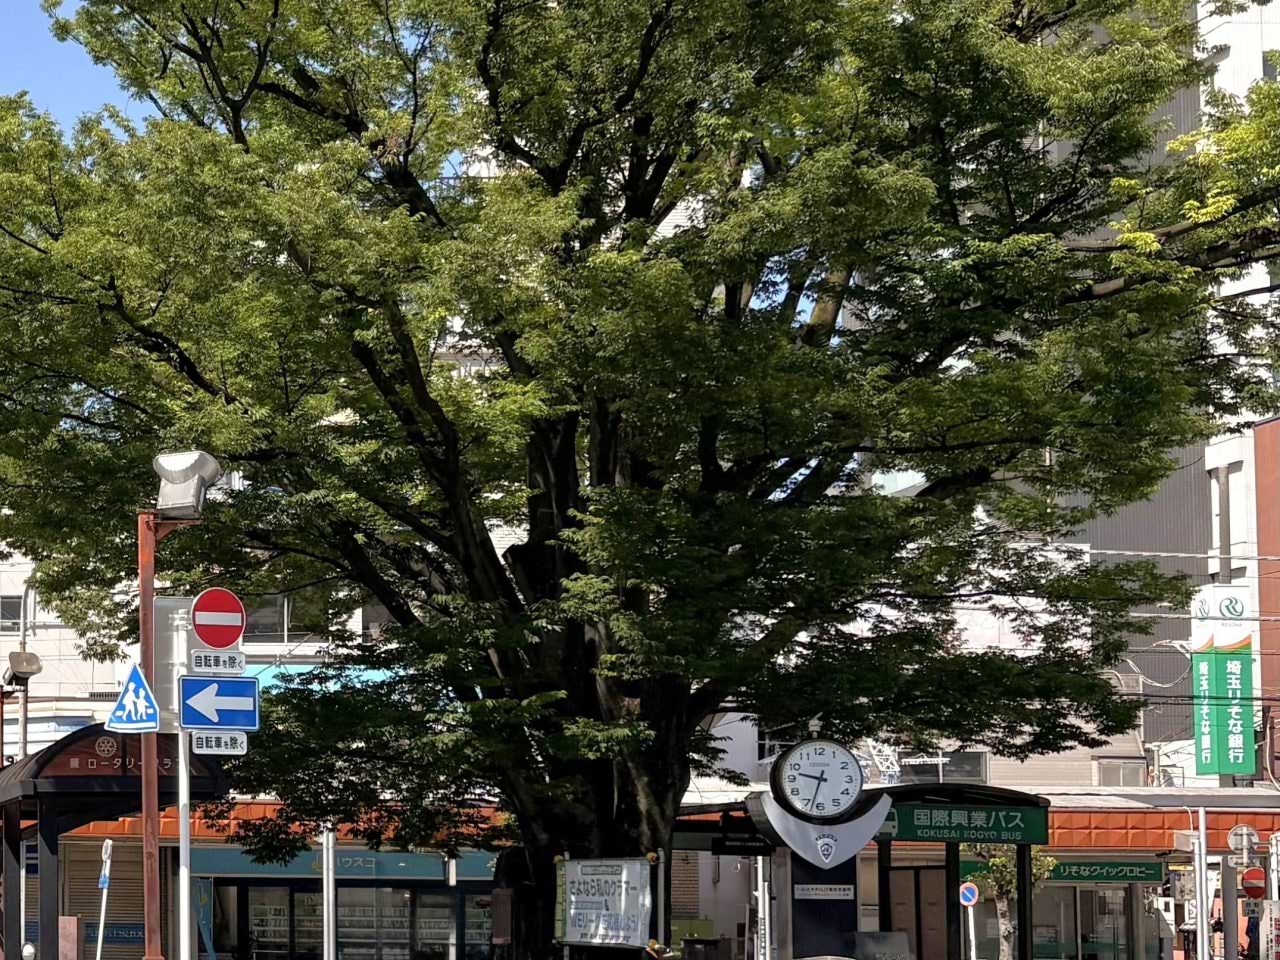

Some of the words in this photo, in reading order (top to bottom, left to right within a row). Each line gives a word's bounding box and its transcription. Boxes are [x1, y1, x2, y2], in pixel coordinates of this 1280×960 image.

[194, 655, 243, 670] 自転車を除く
[1199, 661, 1211, 764] 埼玉りそな銀行
[1226, 660, 1244, 764] 埼玉りそな銀行
[195, 735, 245, 750] 自転車を除く
[800, 752, 810, 760] 11
[814, 747, 825, 756] 12
[88, 758, 180, 769] ロータリラ
[790, 763, 800, 771] 10
[840, 762, 848, 770] 2
[787, 774, 796, 783] 9
[844, 775, 853, 784] 3
[790, 787, 800, 796] 8
[840, 788, 850, 796] 4
[801, 799, 811, 807] 7
[816, 803, 825, 811] 6
[832, 799, 841, 807] 5
[913, 809, 1024, 828] 国際興業バス
[917, 829, 960, 838] KOKUSAI
[964, 830, 997, 839] KOGYO
[1001, 831, 1022, 840] BUS
[1060, 865, 1155, 877] りそなクイックロビー
